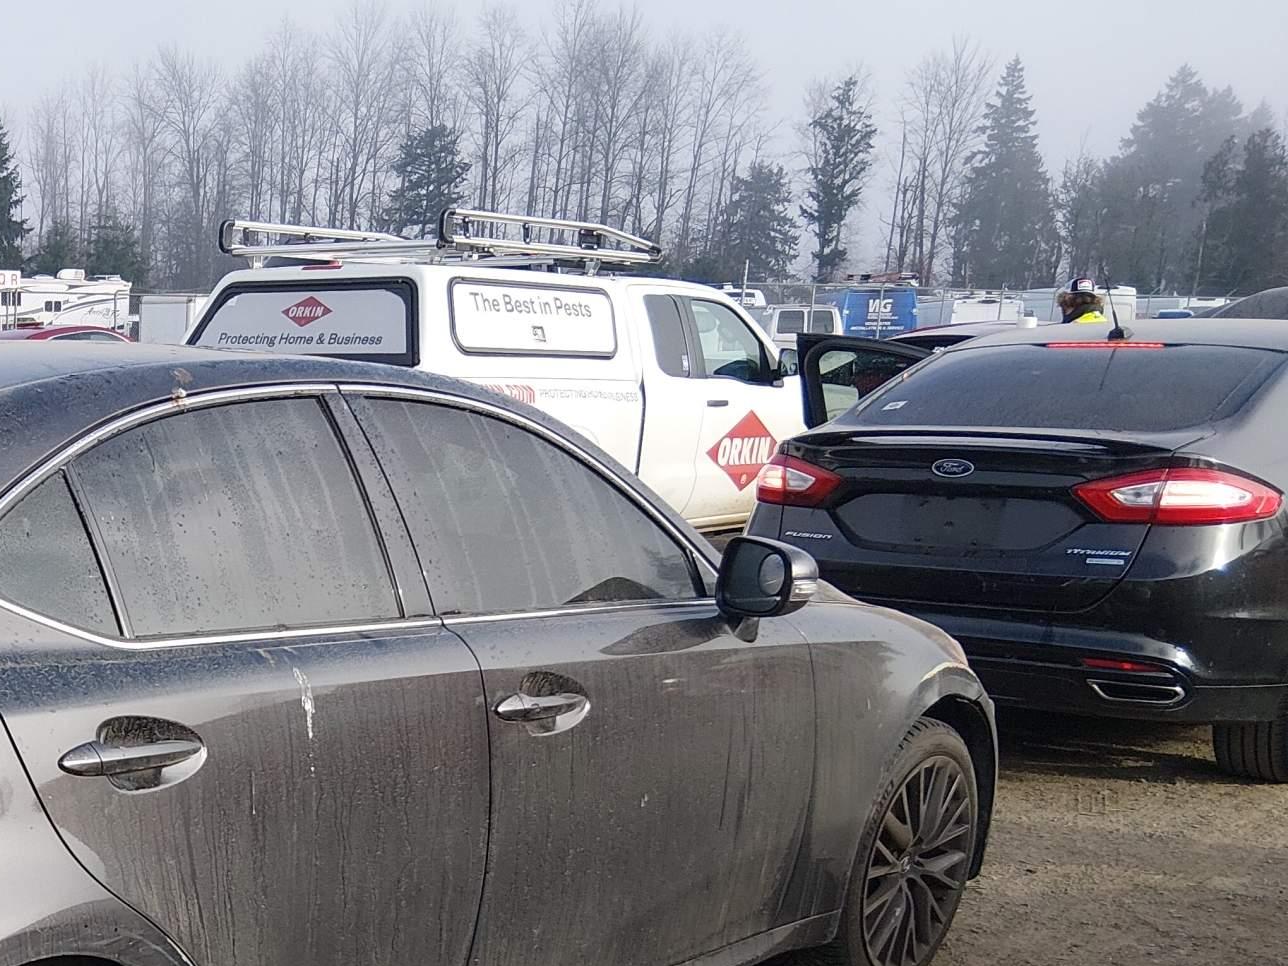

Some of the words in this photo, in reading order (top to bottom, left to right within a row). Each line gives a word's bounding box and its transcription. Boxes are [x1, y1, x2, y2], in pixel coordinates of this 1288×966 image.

[288, 306, 324, 318] ORKIN
[469, 292, 501, 312] The
[502, 294, 537, 314] Best
[537, 296, 553, 315] in
[553, 297, 592, 318] Pests
[218, 332, 277, 348] Protecting
[278, 333, 314, 345] Home
[315, 334, 325, 345] &
[327, 333, 383, 345] Business
[717, 436, 772, 466] ORKIN
[940, 461, 965, 473] Ford
[784, 530, 833, 540] FUSION
